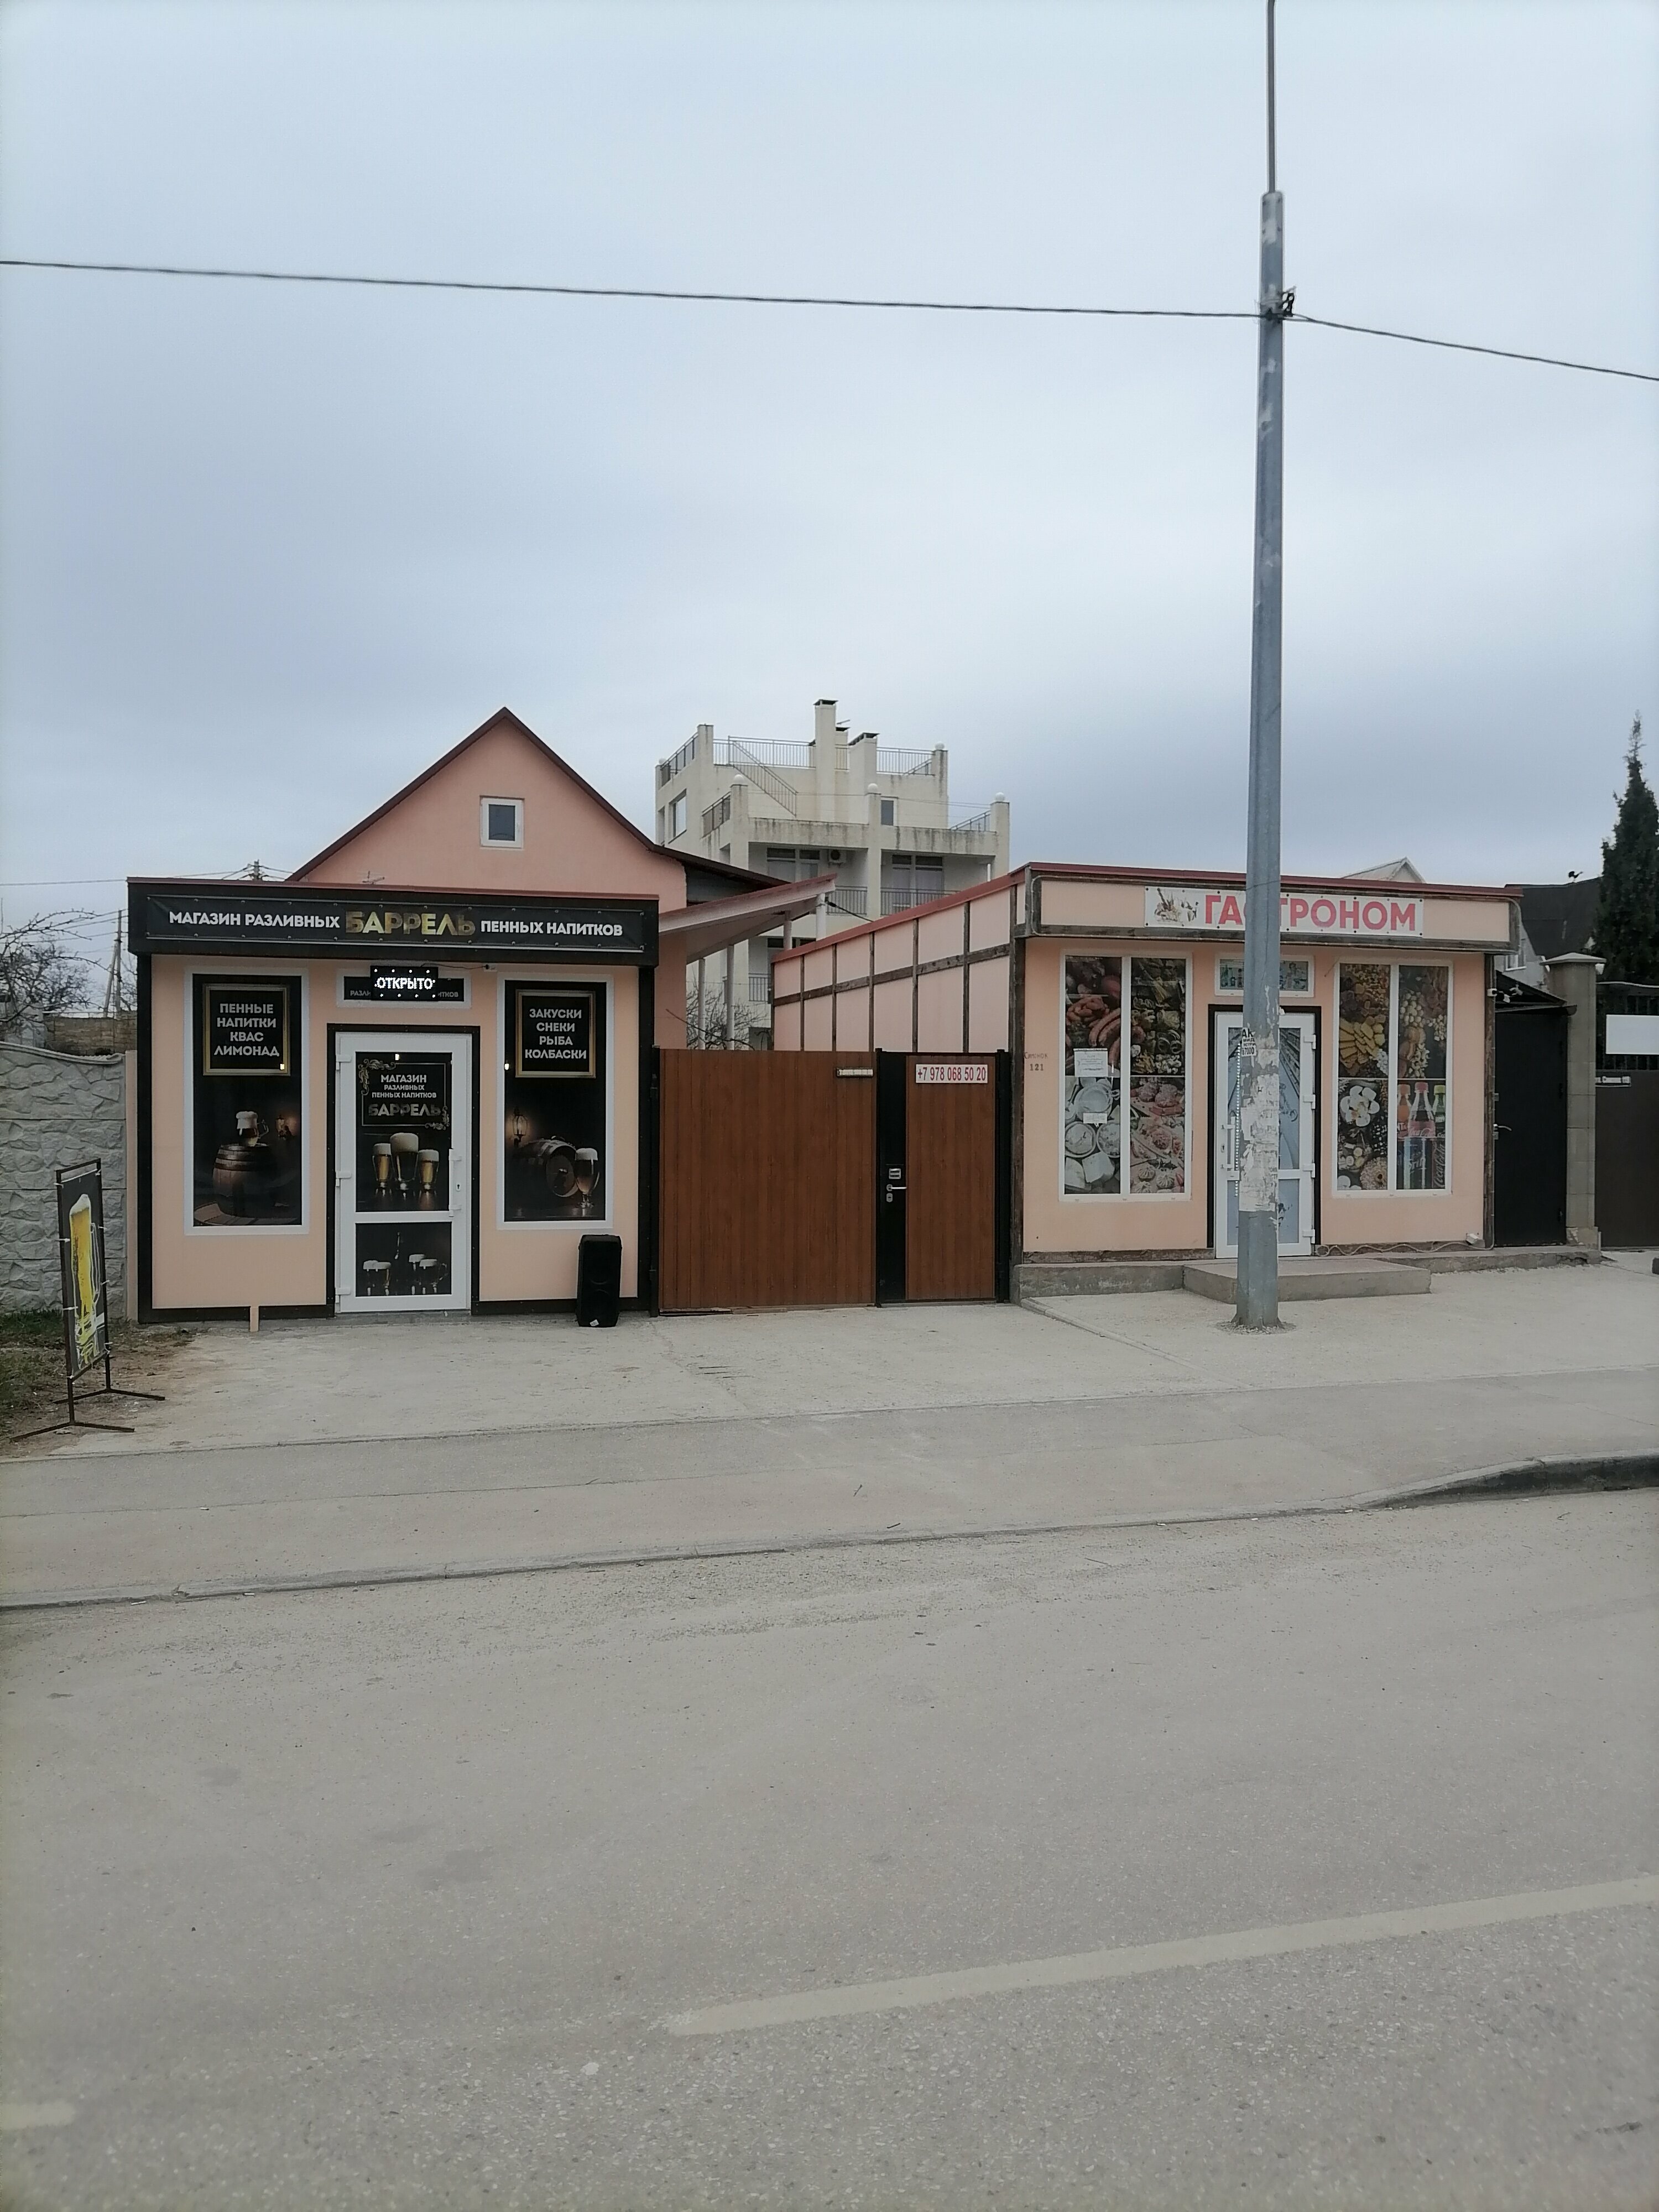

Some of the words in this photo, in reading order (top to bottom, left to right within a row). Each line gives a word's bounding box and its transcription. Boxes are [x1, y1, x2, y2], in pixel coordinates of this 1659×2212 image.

[1205, 895, 1416, 931] ГАРОНОМ
[169, 911, 241, 926] МАГАЗИН
[246, 913, 340, 928] РАЗЛИВНЫХ
[346, 911, 476, 936] БАРРЕЛЬ
[481, 920, 544, 934] ПЕННЫХ
[547, 922, 623, 936] НАПИТКОВ
[377, 977, 433, 990] ОТКРЫТО
[220, 1003, 274, 1014] ПЕННЫЕ
[529, 1009, 582, 1019] ЗАКУСКИ
[217, 1018, 276, 1027] НАПИТКИ
[536, 1022, 575, 1032] СНЕКИ
[230, 1031, 264, 1041] КВАС
[539, 1036, 573, 1045] РЫБА
[214, 1045, 280, 1057] ЛИМОНАД
[525, 1049, 587, 1059] КОЛБАСКИ
[381, 1074, 427, 1083] МАГАЗИН
[918, 1067, 927, 1081] +7
[930, 1067, 945, 1081] 978
[947, 1067, 962, 1081] 068
[964, 1067, 974, 1081] 50
[977, 1067, 986, 1081] 20
[368, 1103, 441, 1117] БАРРЕЛЬ
